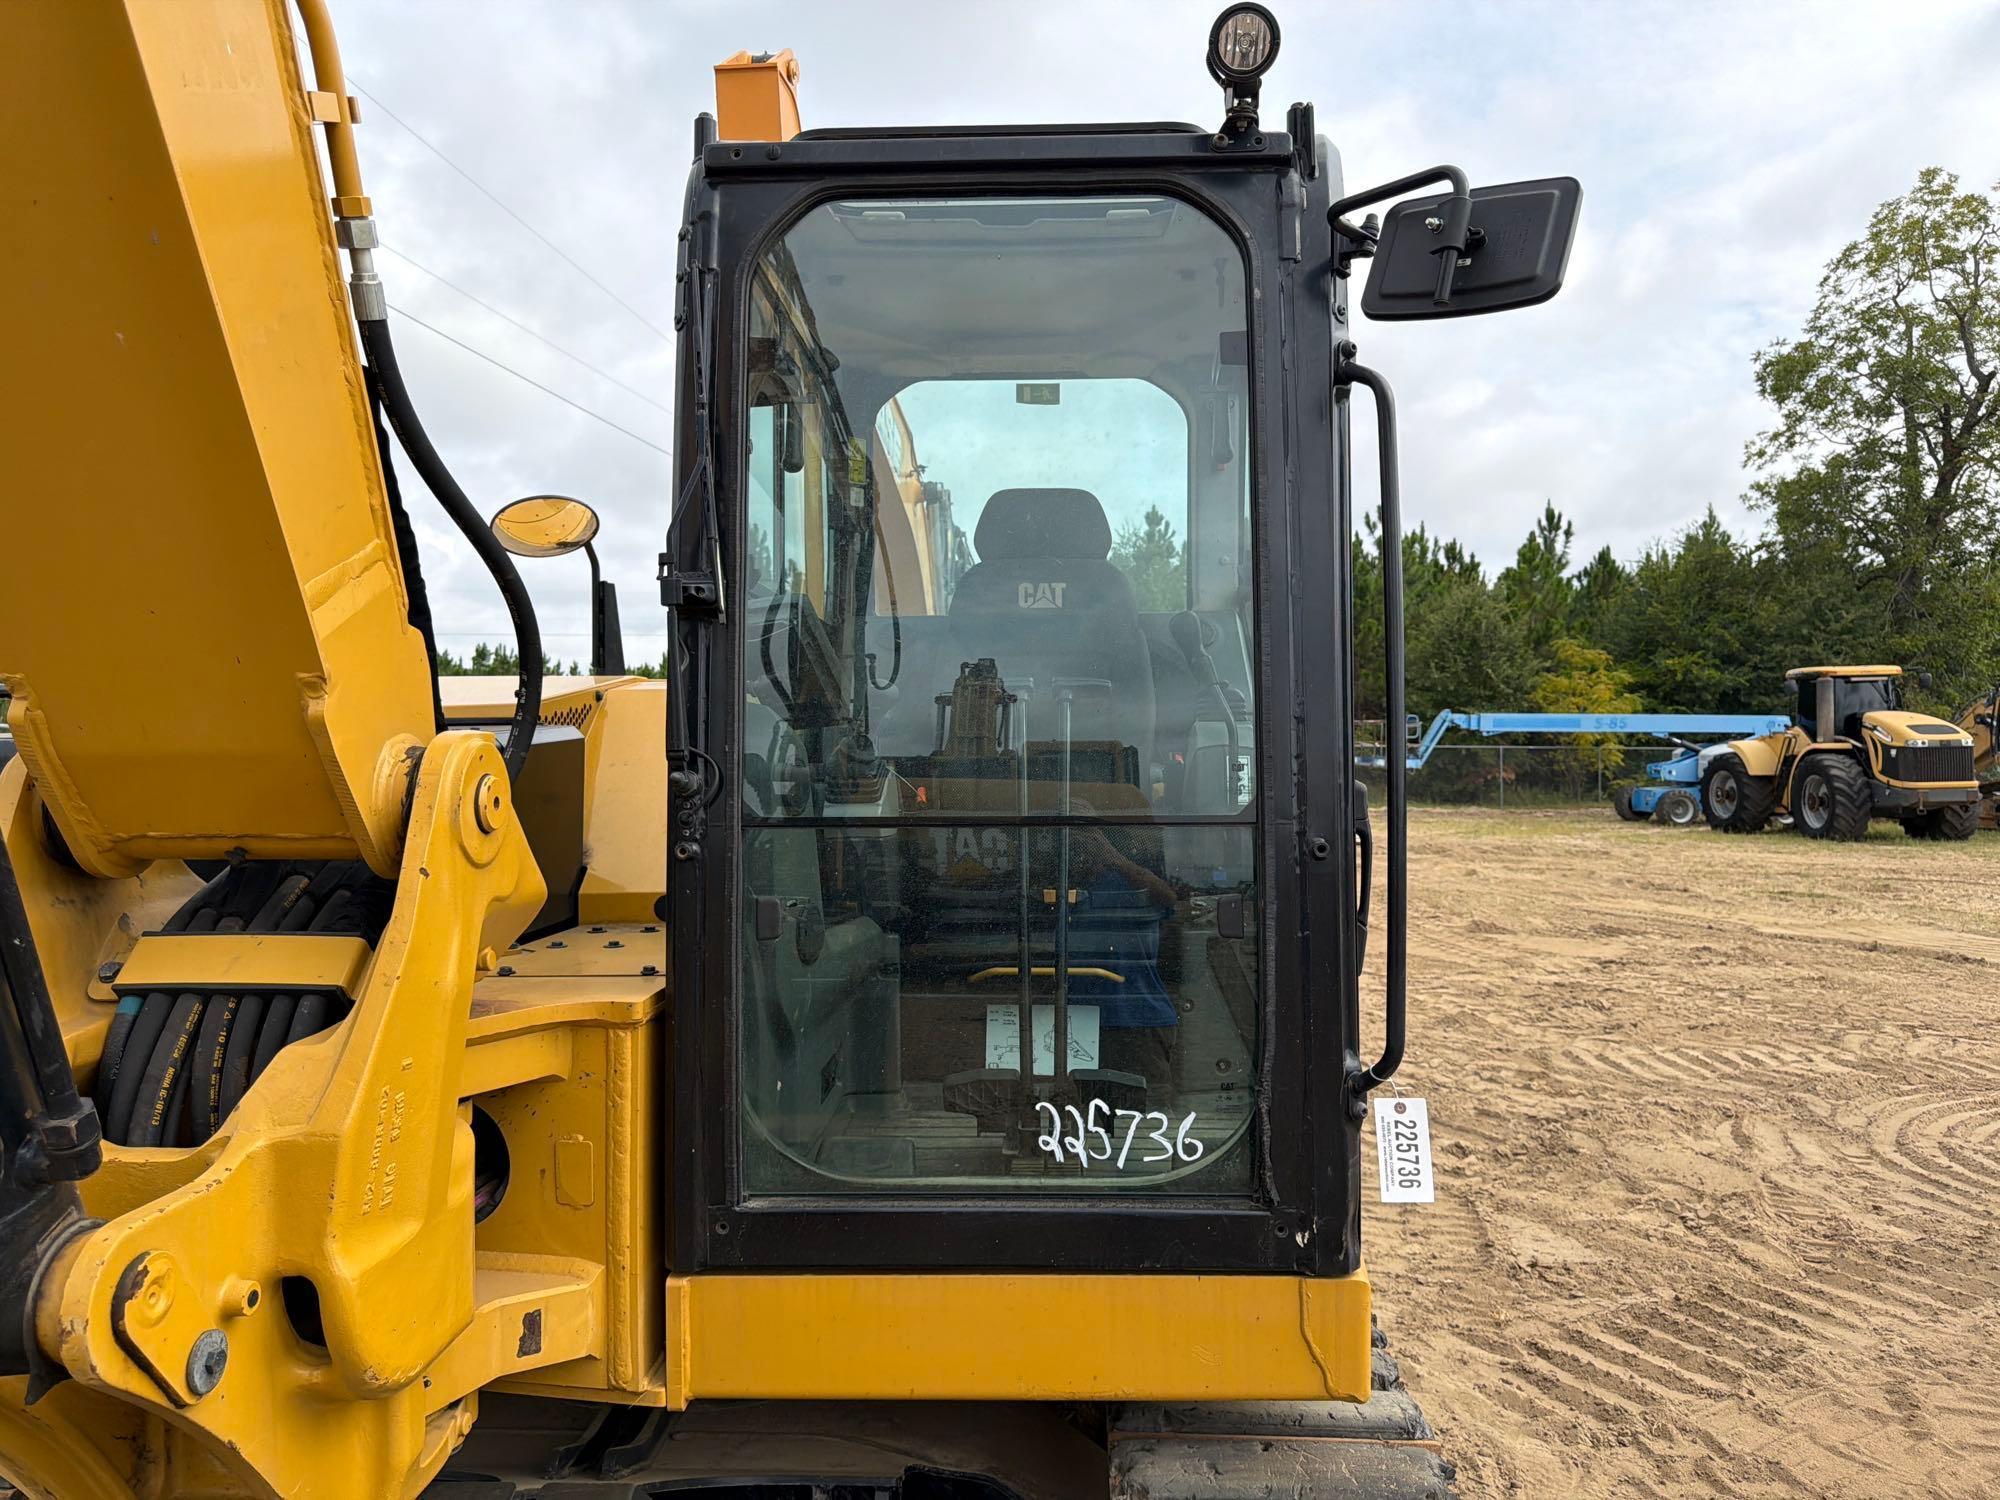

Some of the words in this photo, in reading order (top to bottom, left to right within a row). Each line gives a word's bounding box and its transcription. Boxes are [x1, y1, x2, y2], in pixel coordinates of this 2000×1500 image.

[1018, 582, 1067, 609] CAT
[1594, 717, 1627, 729] S-85
[162, 1066, 176, 1088] MSHA
[1035, 1098, 1203, 1170] 225736
[1394, 1119, 1422, 1189] 225736
